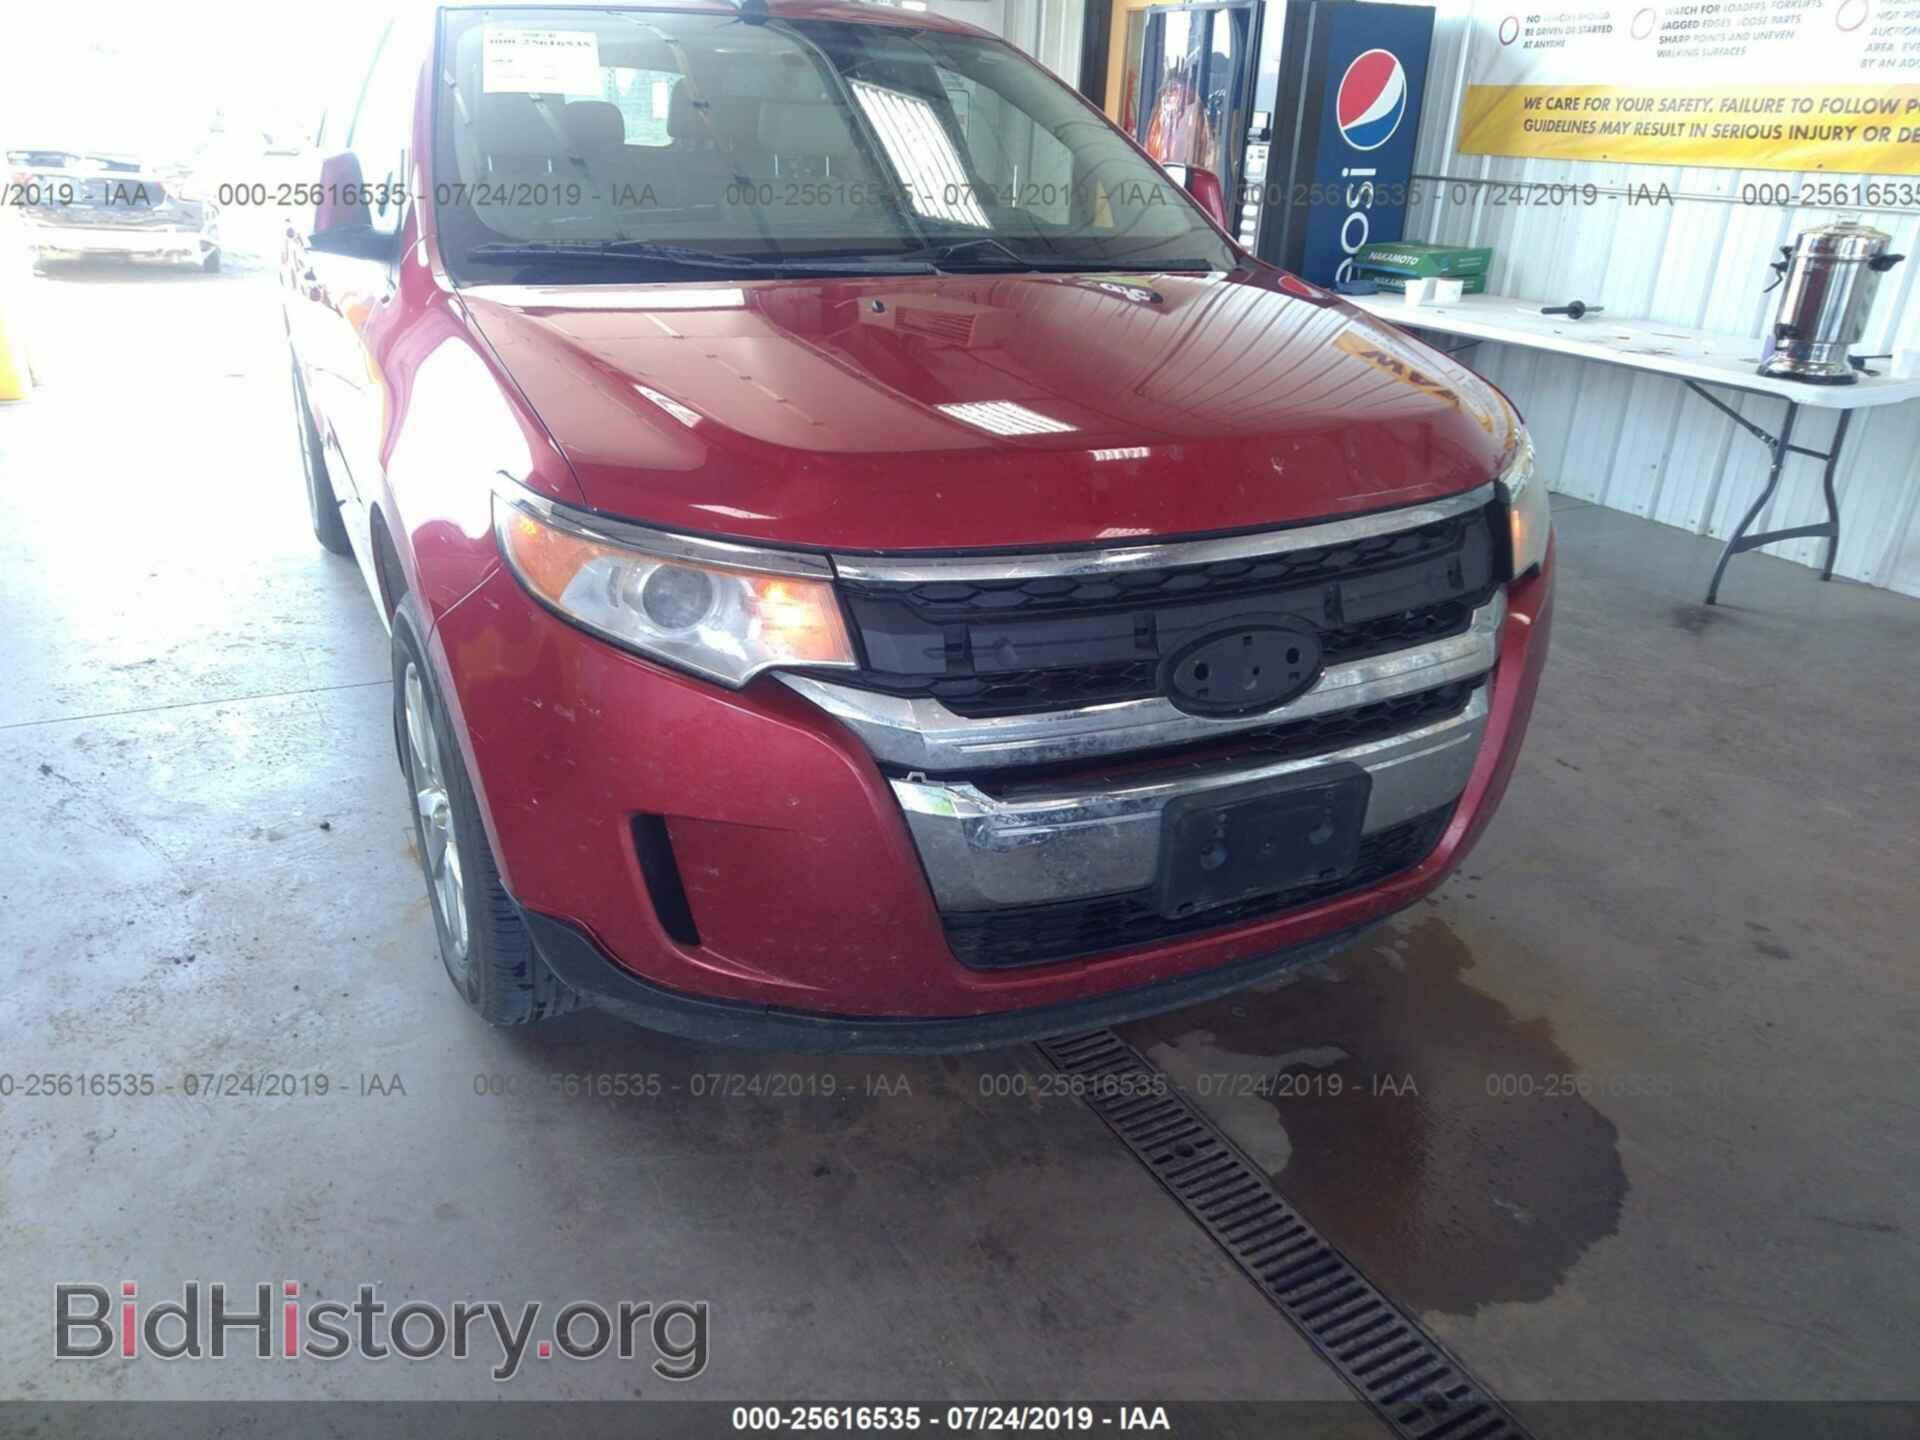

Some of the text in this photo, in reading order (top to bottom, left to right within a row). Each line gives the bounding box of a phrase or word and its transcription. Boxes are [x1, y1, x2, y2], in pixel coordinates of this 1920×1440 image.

[1700, 4, 1720, 15] FOR
[1526, 14, 1541, 24] NO
[1661, 20, 1699, 31] JAGGED
[1524, 96, 1543, 110] WE
[1546, 97, 1581, 110] CARE
[1584, 98, 1609, 111] FOR
[1616, 98, 1654, 112] YOUR
[1658, 98, 1714, 113] SAFETY.
[1719, 98, 1785, 113] FAILURE
[1791, 98, 1814, 114] TO
[1818, 98, 1901, 114] FOLLOW
[1524, 119, 1597, 134] GUIDELINES
[1600, 121, 1632, 135] MAY
[1634, 122, 1686, 136] RESULT
[1689, 123, 1707, 138] IN
[1711, 123, 1783, 140] SERIOUS
[1788, 125, 1857, 141] INJURY
[1863, 126, 1892, 142] OR
[1367, 251, 1421, 266] NAKAMOTO
